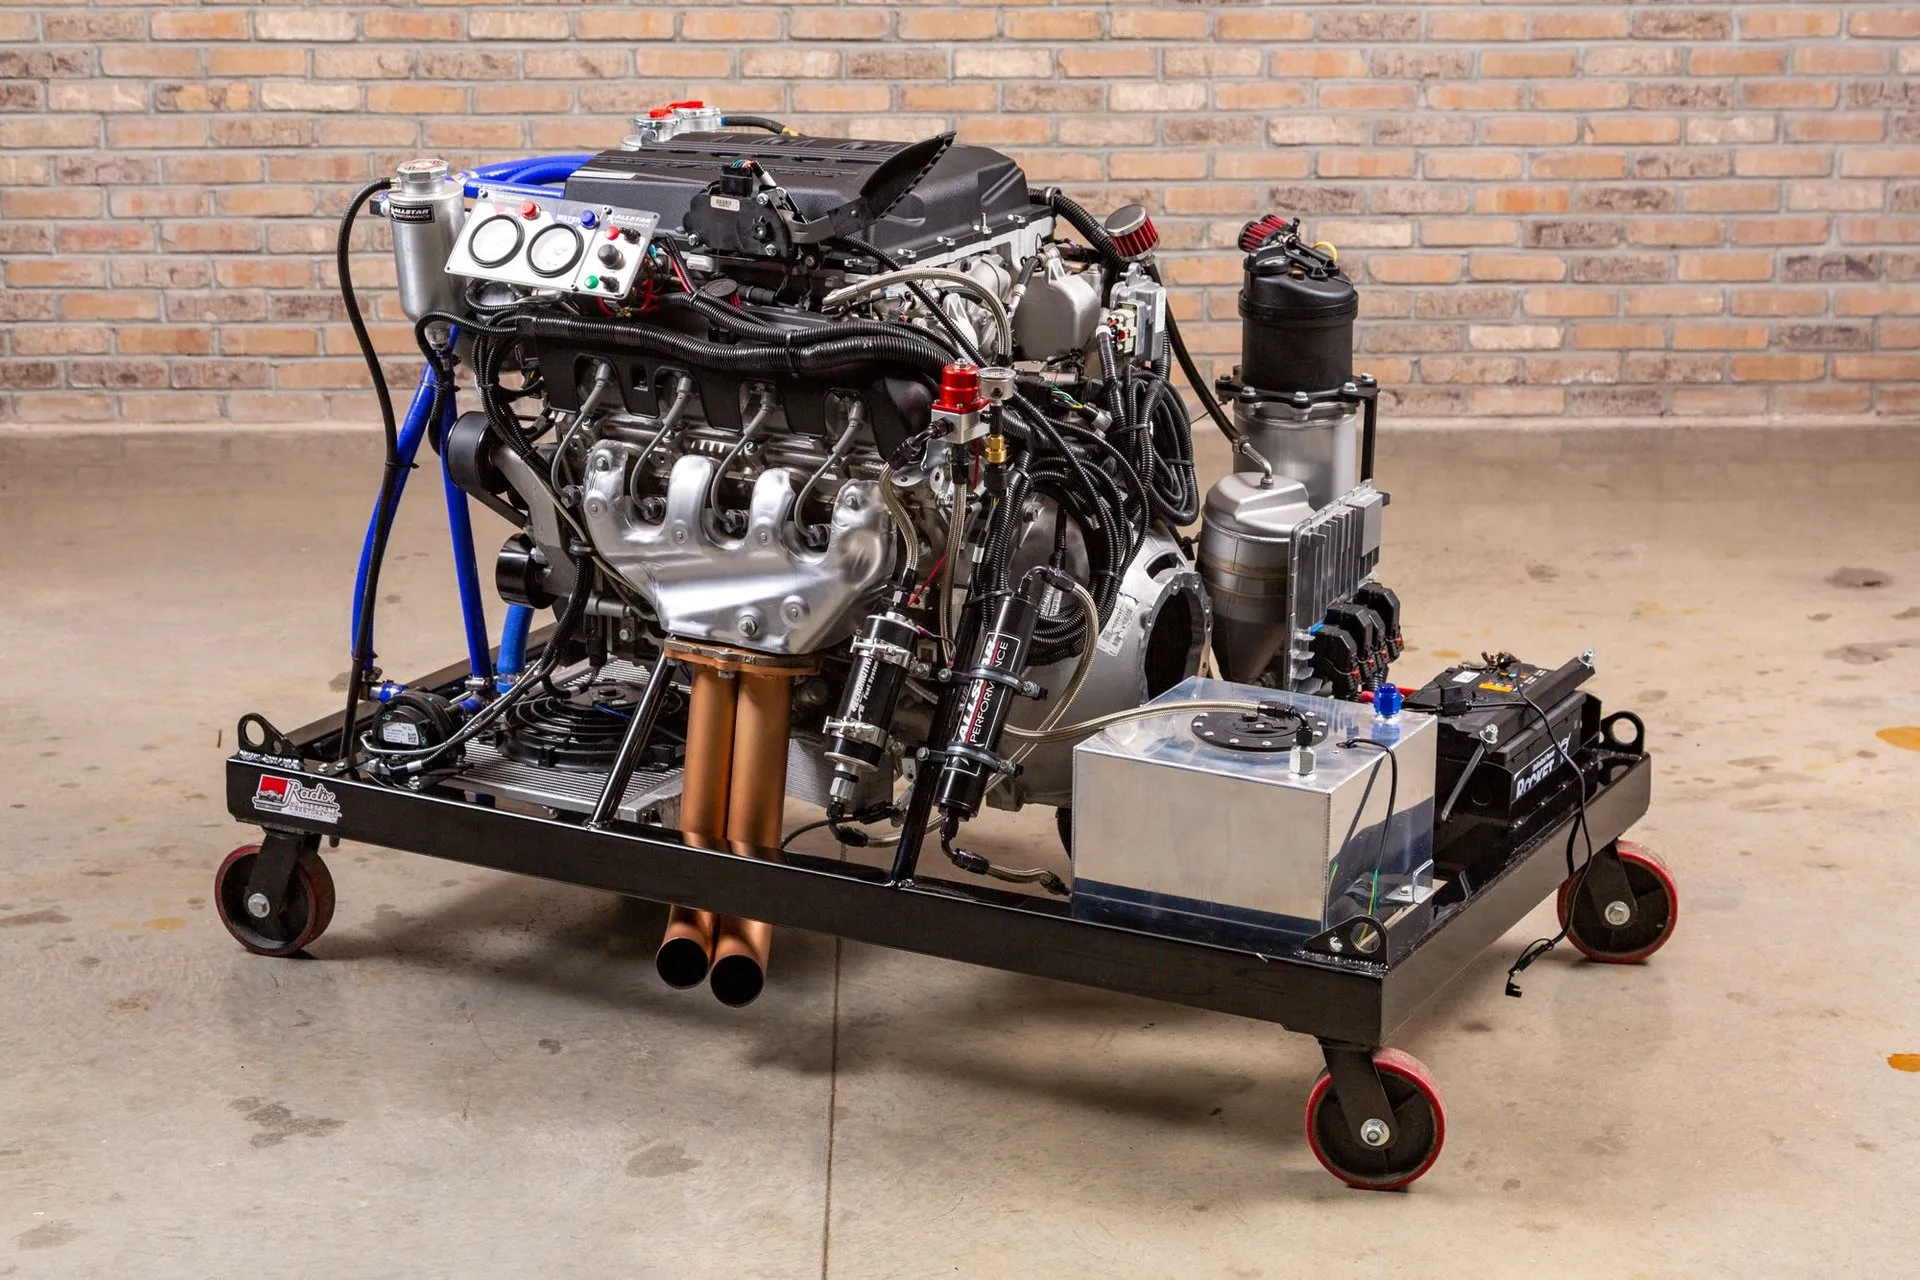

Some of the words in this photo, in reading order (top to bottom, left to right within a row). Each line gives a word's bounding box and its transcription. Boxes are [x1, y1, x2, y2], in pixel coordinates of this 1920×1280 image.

[392, 207, 429, 215] ALLSTAR
[613, 214, 652, 224] ALLSTAR
[850, 657, 872, 712] AEROMOTIV
[970, 640, 1008, 743] PERFORMNCE
[287, 779, 336, 804] Radix
